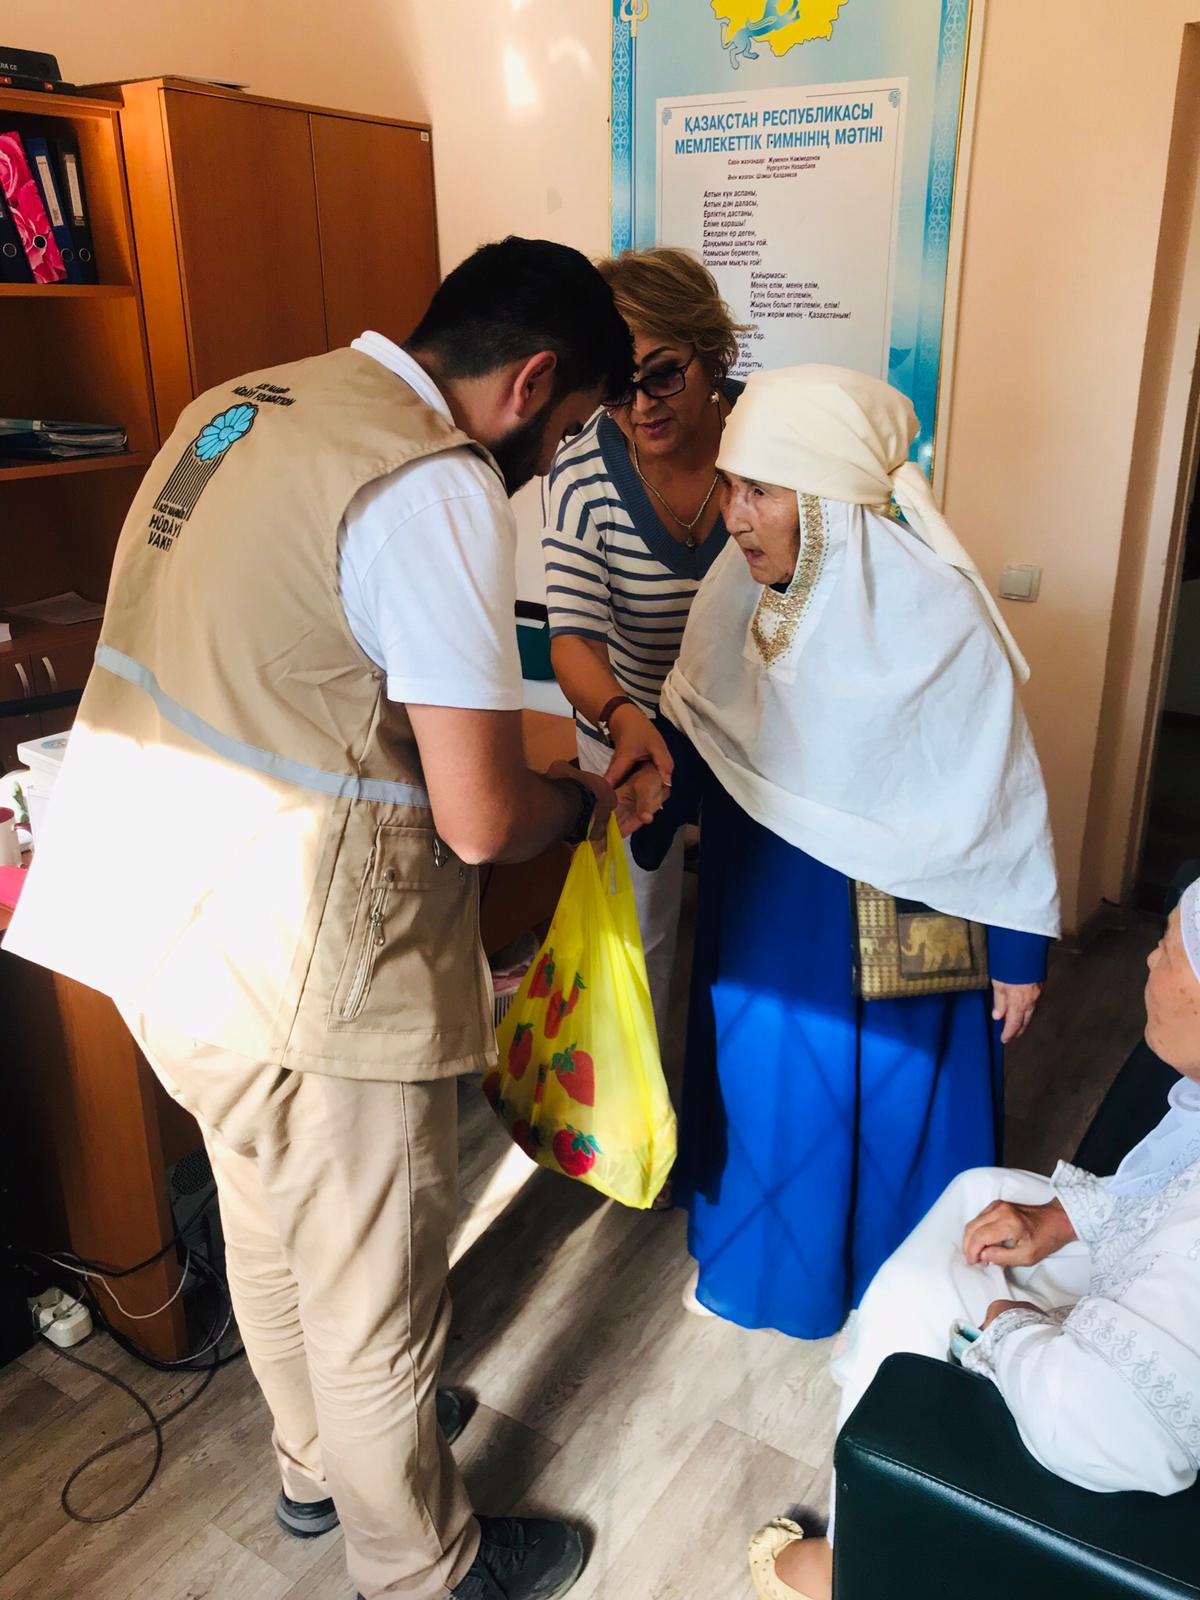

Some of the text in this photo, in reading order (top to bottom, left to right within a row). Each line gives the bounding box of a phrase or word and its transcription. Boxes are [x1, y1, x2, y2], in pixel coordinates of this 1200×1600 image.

[684, 102, 873, 134] ҚАЗАҚСТАН РЕСПУБЛИКАСЫ
[675, 126, 883, 154] МЕМЛЕКЕТТІК ГИМНІНІҢ МӘТІНІ
